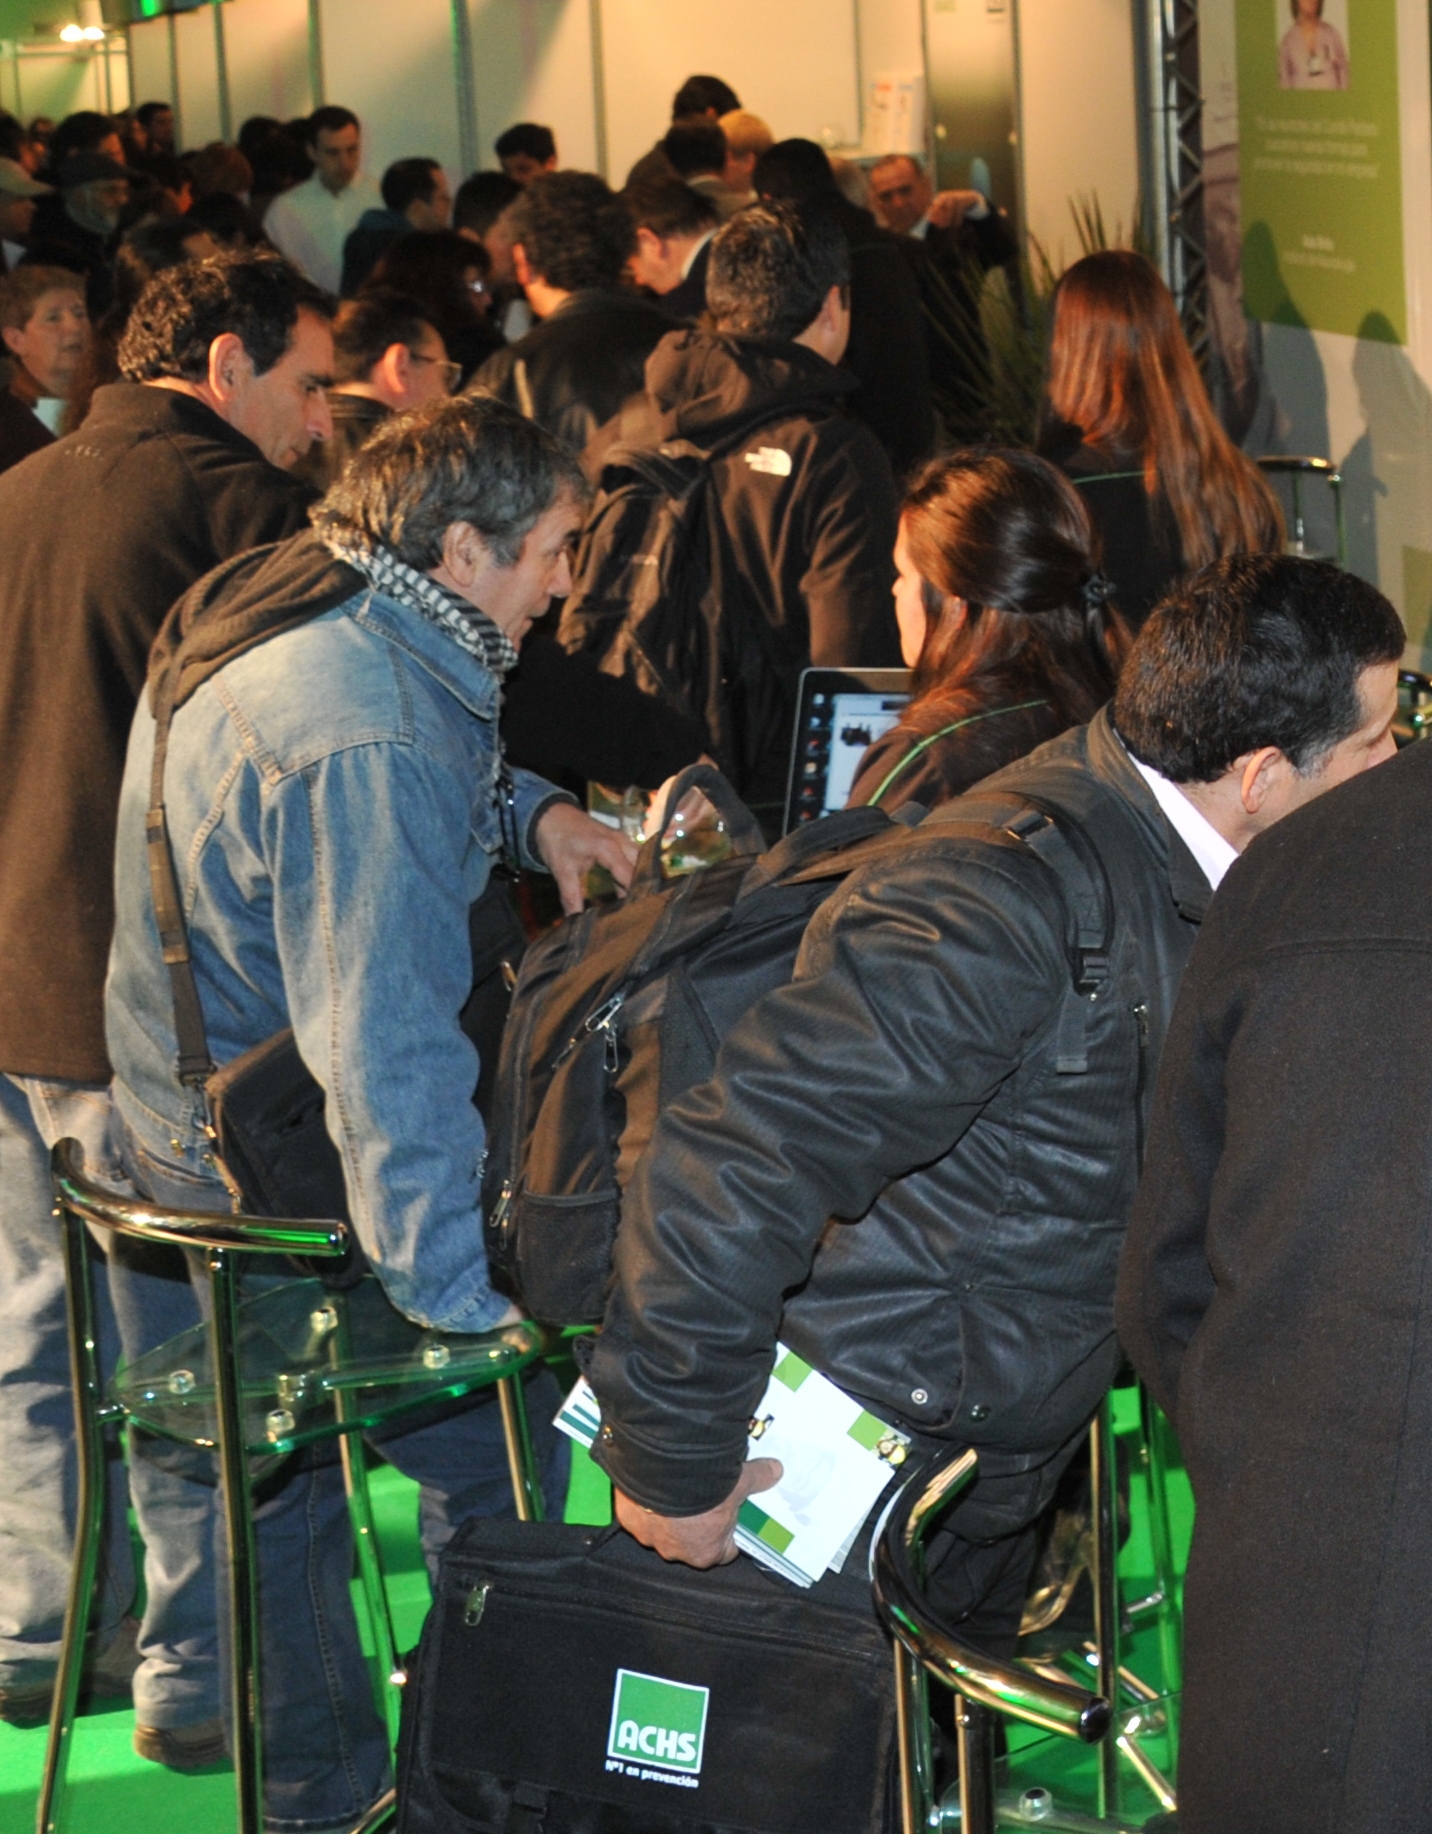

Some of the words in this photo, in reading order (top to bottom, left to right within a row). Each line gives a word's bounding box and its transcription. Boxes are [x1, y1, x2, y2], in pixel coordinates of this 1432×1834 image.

[617, 1719, 696, 1762] ACHS
[626, 1766, 640, 1777] en
[641, 1769, 699, 1788] prevención
